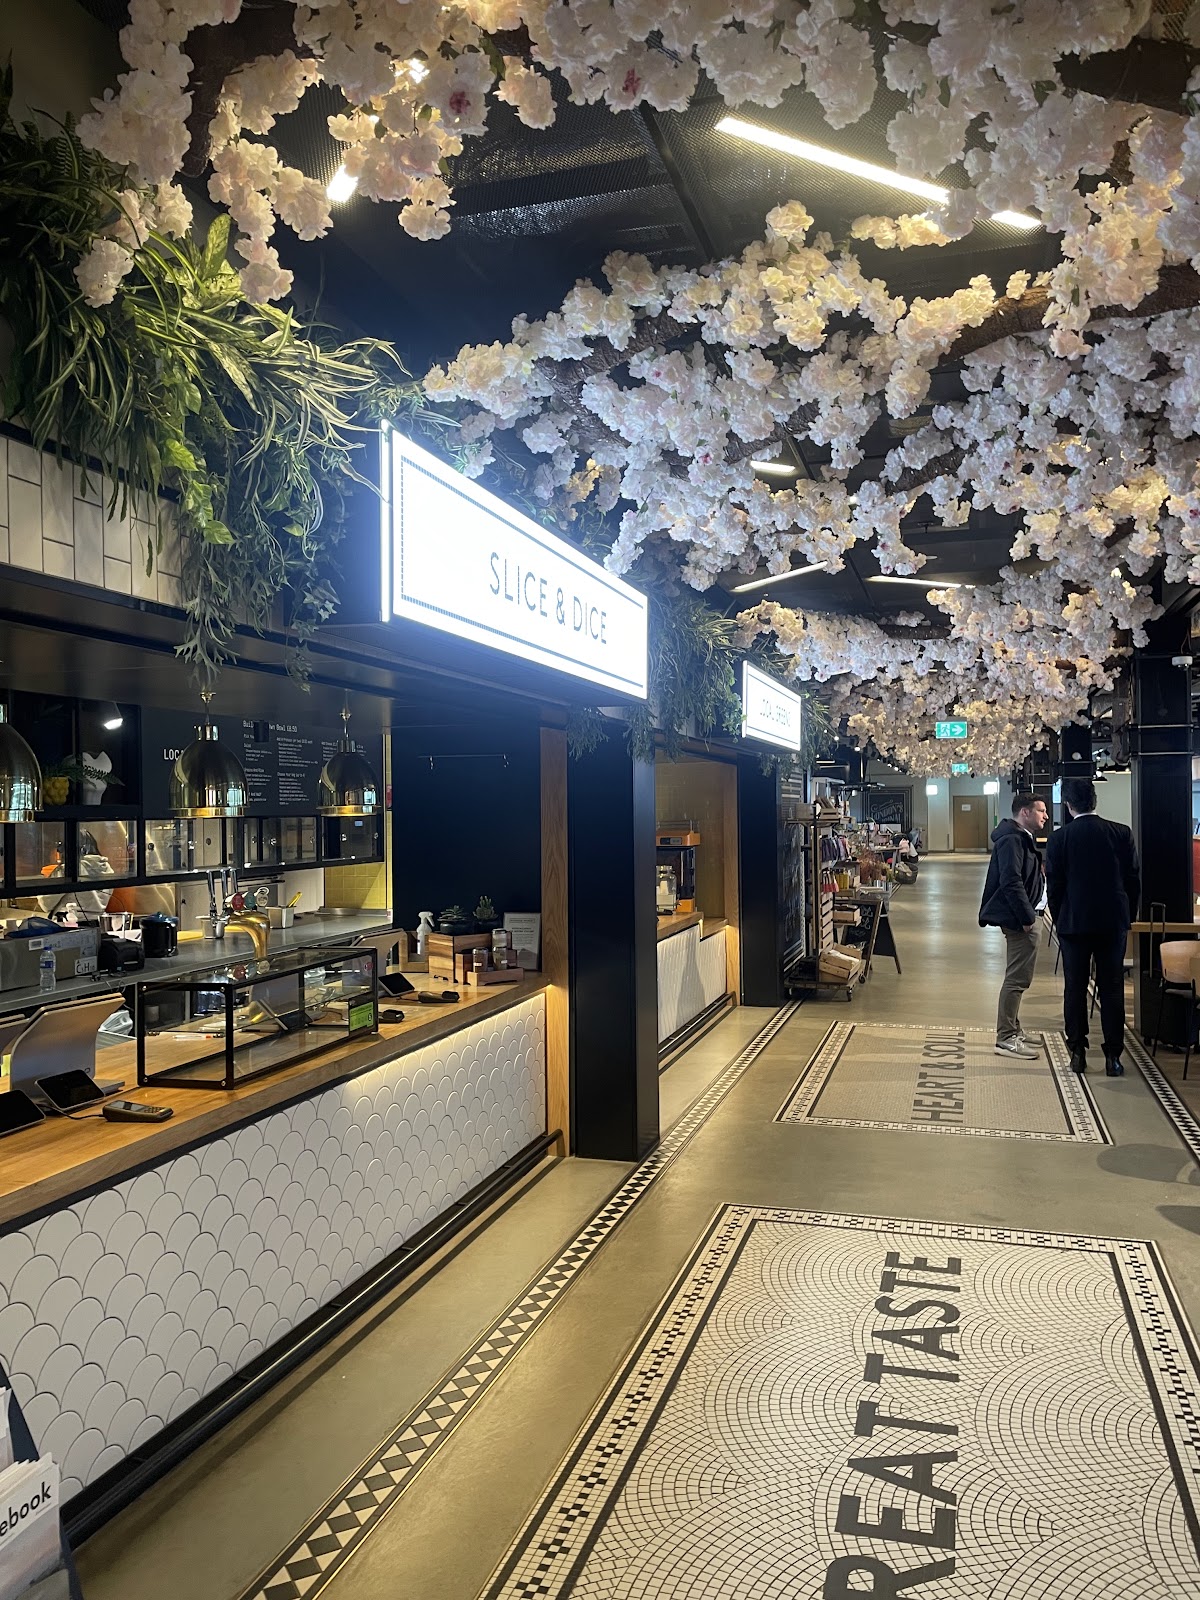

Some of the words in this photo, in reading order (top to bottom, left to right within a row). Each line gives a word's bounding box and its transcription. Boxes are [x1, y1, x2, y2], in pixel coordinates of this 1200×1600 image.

[490, 552, 548, 617] SLICE
[556, 587, 566, 626] &
[573, 596, 607, 645] DICE
[163, 748, 184, 761] LOC
[921, 1032, 966, 1059] SOUL
[920, 1062, 965, 1070] &
[911, 1072, 965, 1123] HEART
[863, 1251, 962, 1383] TASTE
